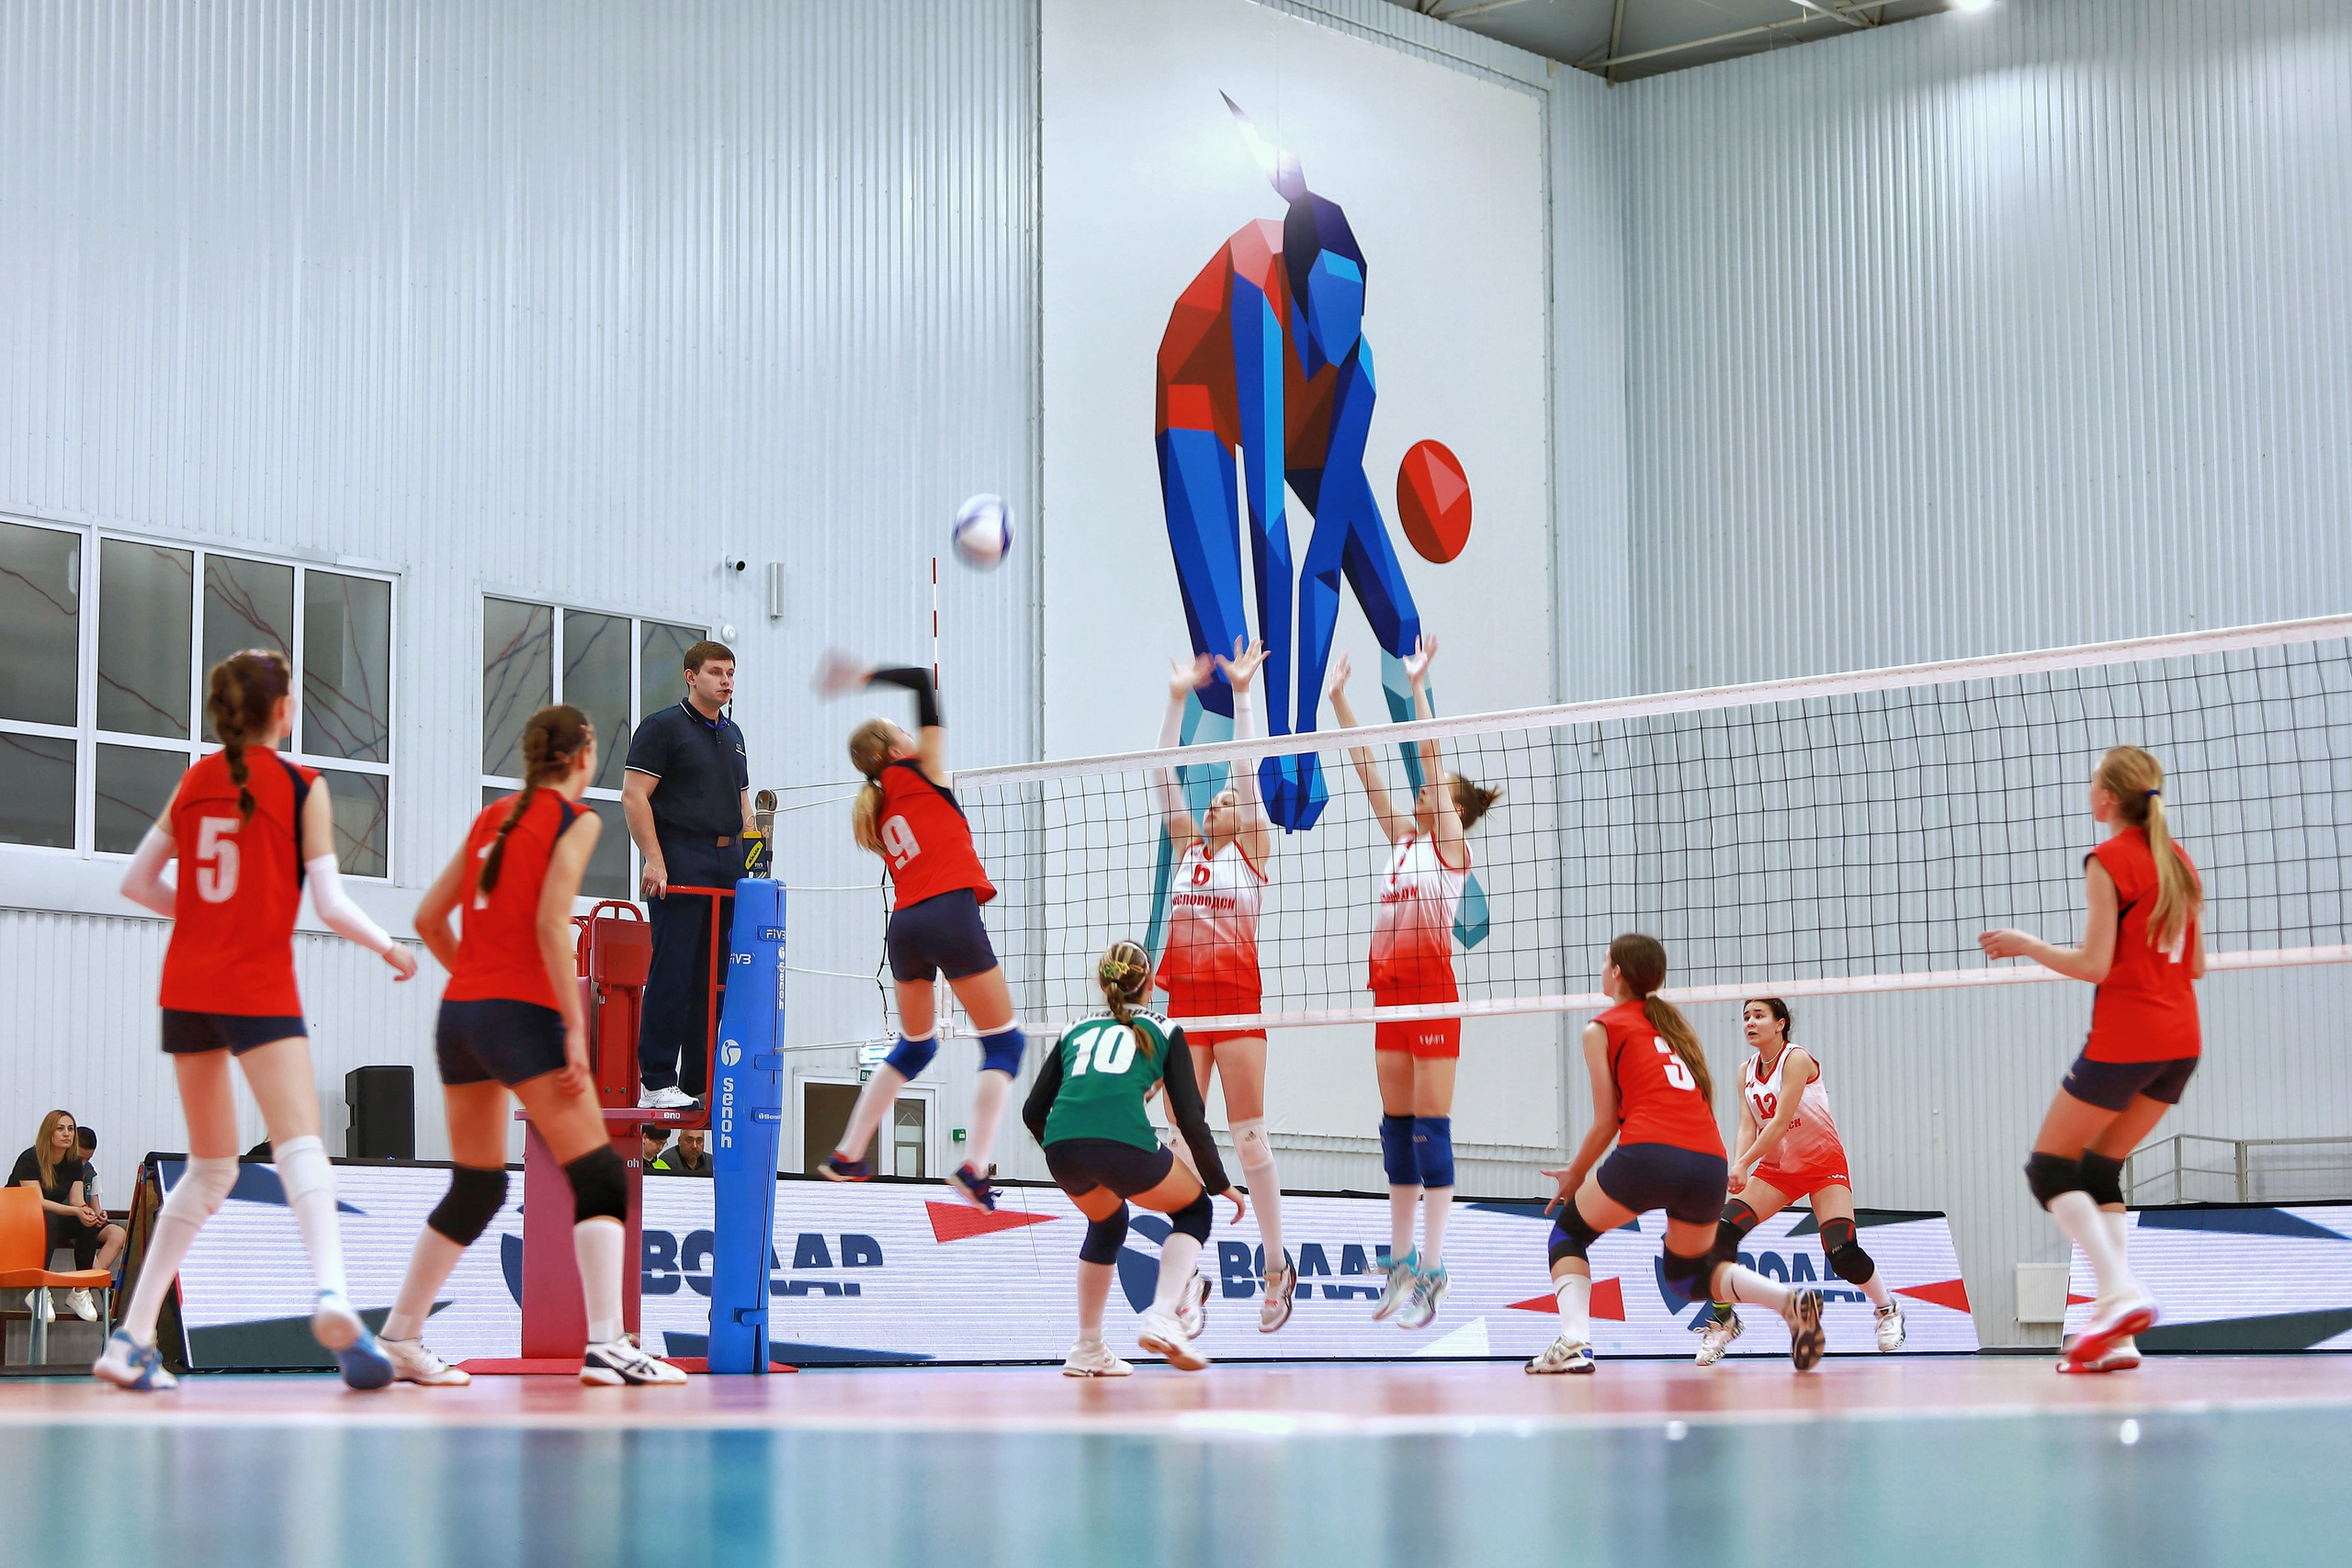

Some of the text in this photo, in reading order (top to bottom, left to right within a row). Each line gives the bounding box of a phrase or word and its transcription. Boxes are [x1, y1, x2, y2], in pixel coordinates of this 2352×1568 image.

[196, 816, 242, 904] 5
[882, 815, 922, 871] 9
[1071, 1024, 1137, 1077] 10
[1654, 1035, 1696, 1091] 3
[1753, 1091, 1779, 1120] 12
